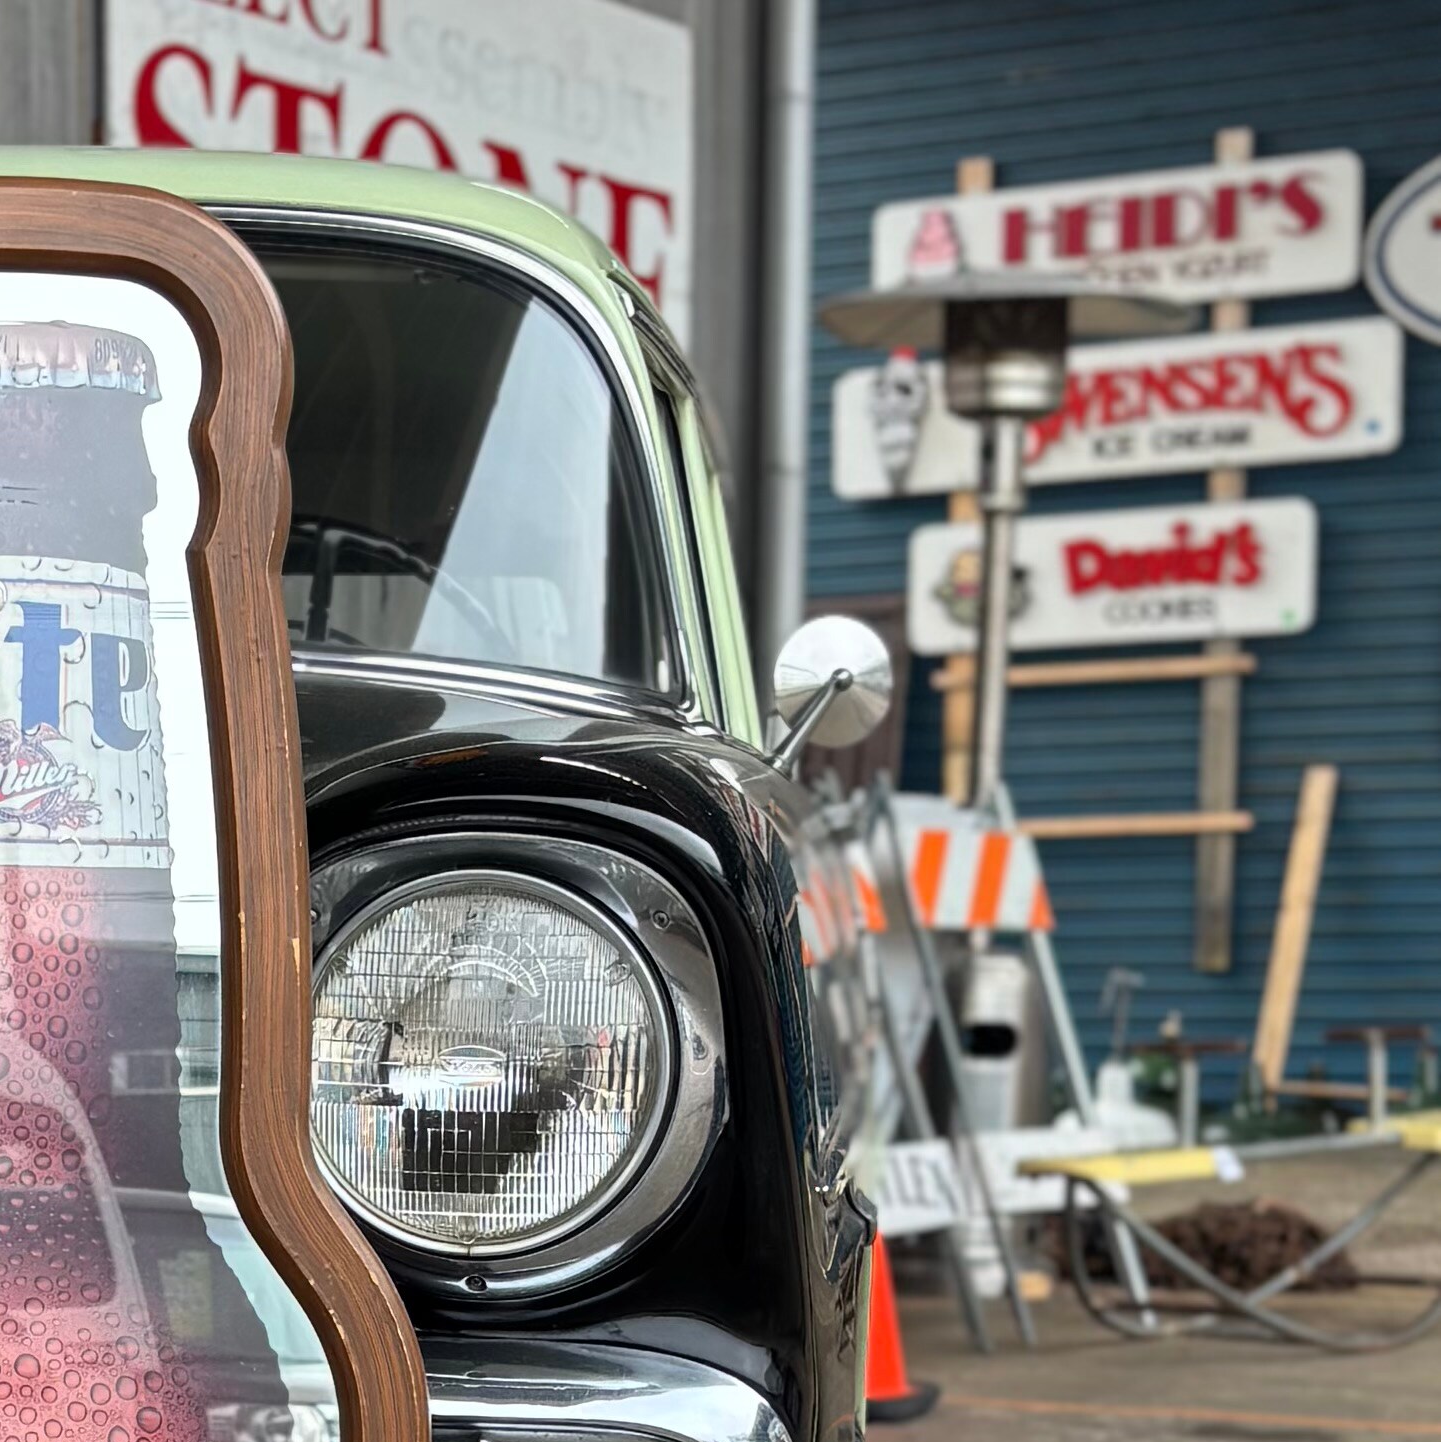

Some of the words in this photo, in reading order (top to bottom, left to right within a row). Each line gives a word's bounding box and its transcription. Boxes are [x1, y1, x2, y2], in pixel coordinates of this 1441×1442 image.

[1001, 169, 1325, 265] HEIDI'S
[1024, 343, 1353, 464] WENSEN'S
[1063, 519, 1263, 597] David's
